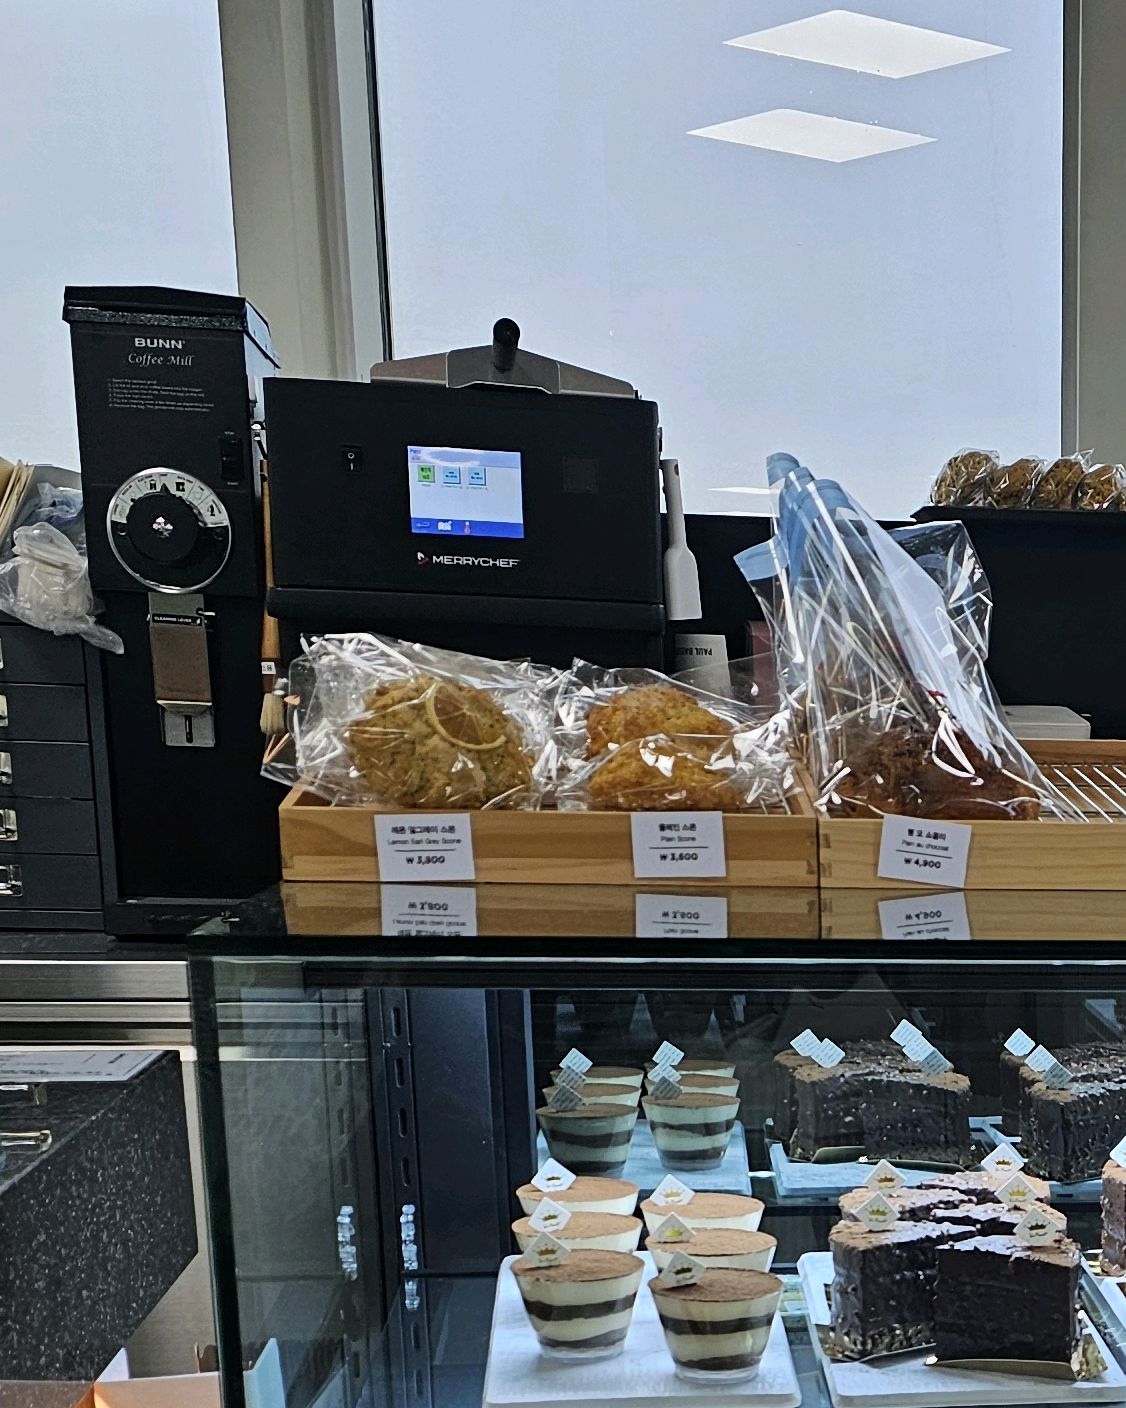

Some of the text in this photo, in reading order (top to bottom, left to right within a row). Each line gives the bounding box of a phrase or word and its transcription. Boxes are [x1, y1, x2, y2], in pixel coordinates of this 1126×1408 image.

[134, 338, 183, 349] BUNN
[128, 354, 194, 367] Coffee Mill
[432, 556, 520, 568] MERRYCHEF
